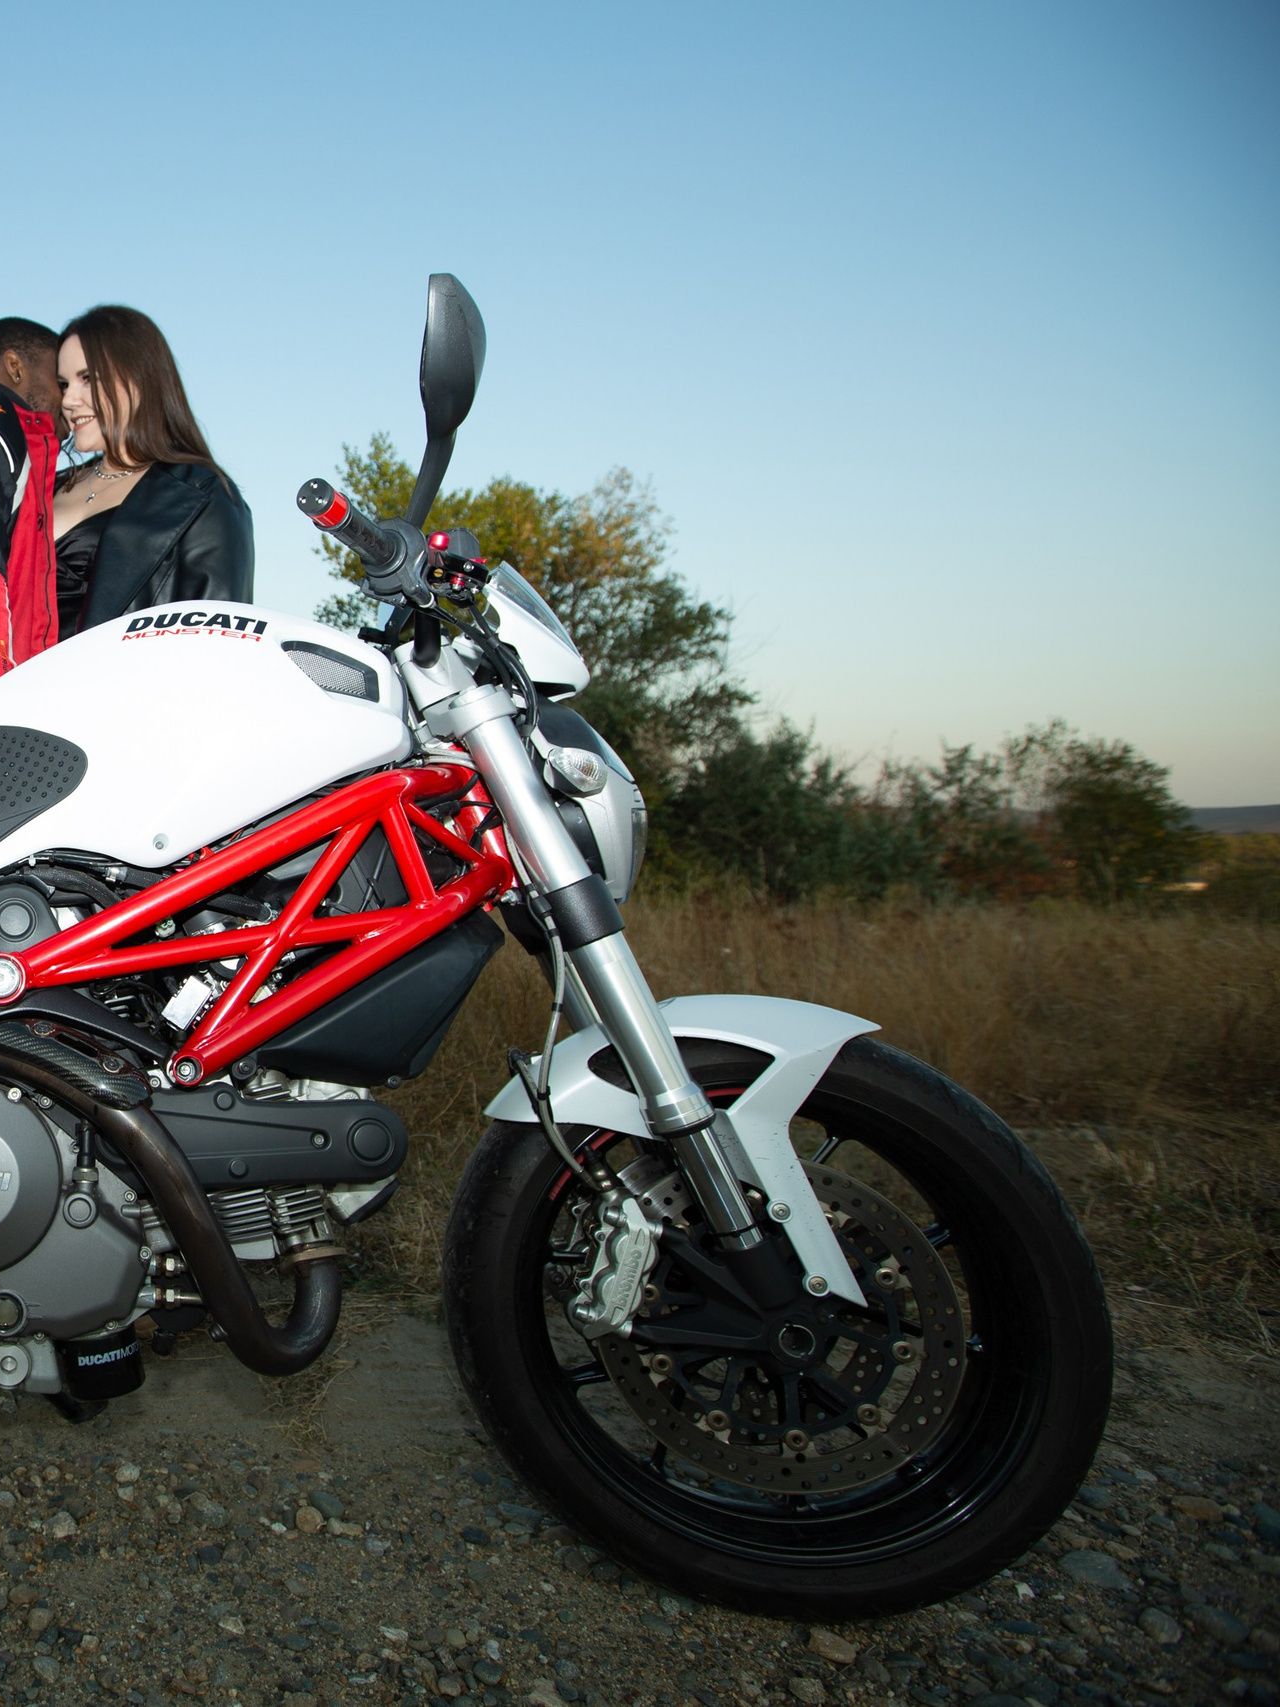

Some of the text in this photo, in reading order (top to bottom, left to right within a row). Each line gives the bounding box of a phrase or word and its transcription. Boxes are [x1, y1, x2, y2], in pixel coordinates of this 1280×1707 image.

[122, 628, 262, 642] MONSTER
[126, 612, 268, 635] DUCATI
[612, 1249, 643, 1308] brembo
